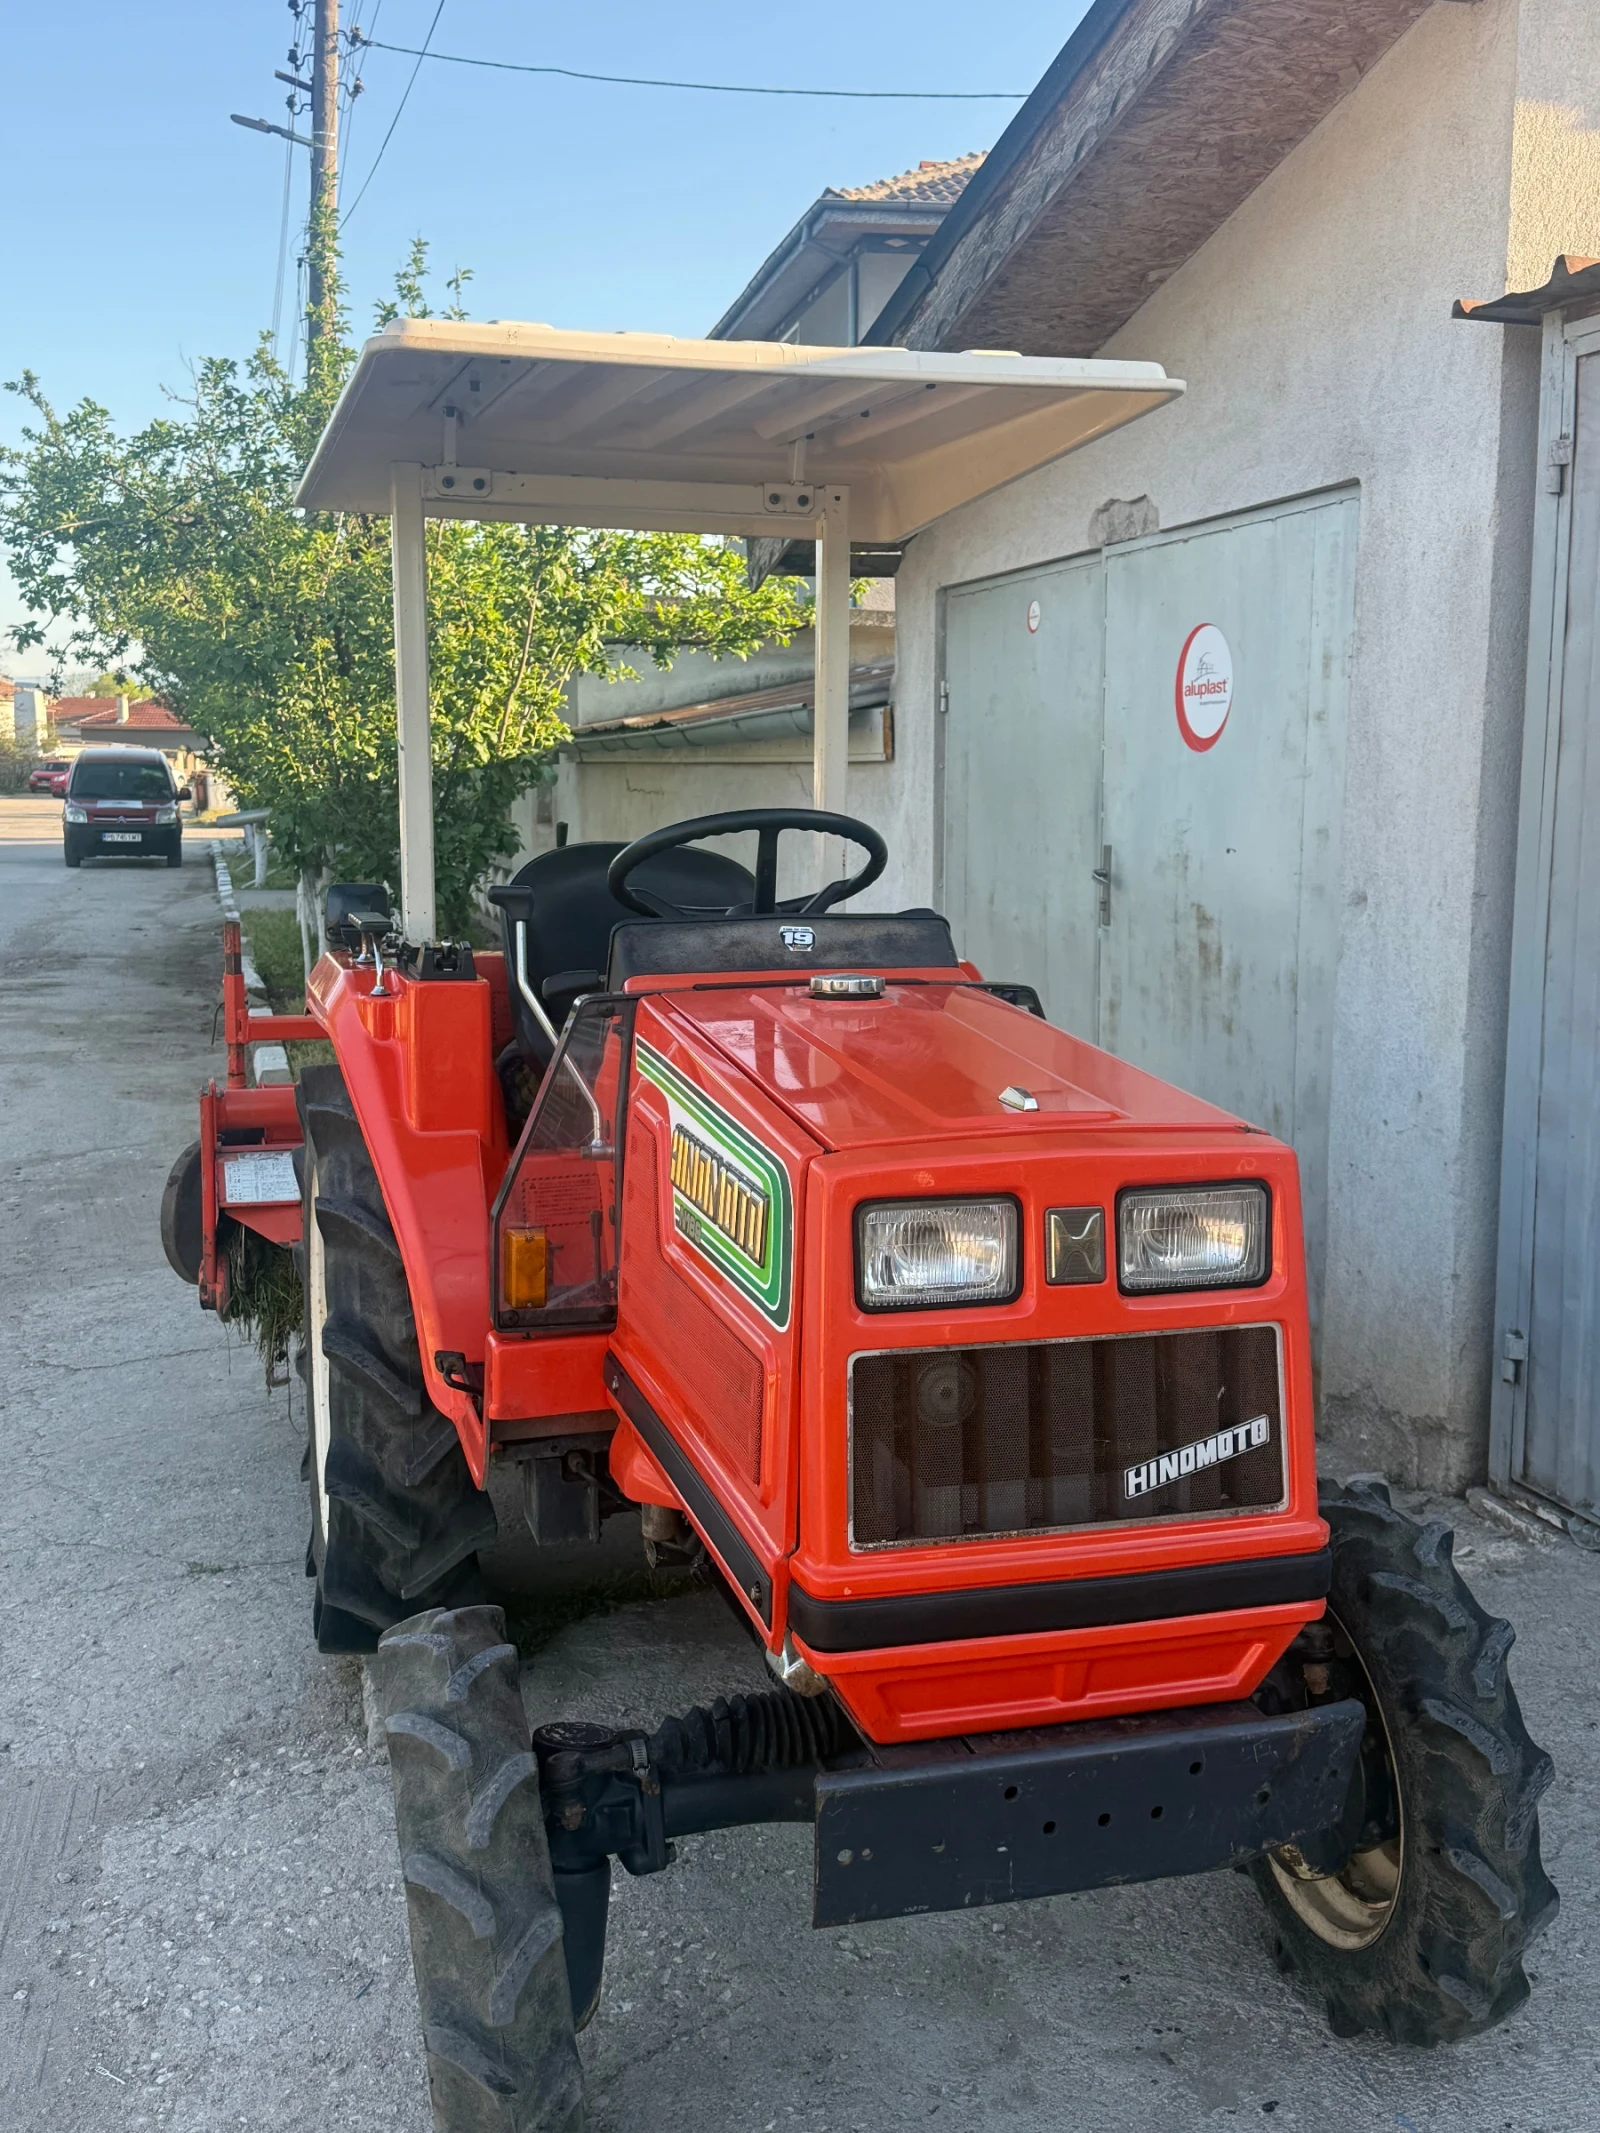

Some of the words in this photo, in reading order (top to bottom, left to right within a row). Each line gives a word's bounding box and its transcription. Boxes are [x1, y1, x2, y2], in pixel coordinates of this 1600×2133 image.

[1184, 678, 1227, 699] aluplast
[783, 932, 813, 945] 19
[1127, 1416, 1267, 1497] HINOMOTO
